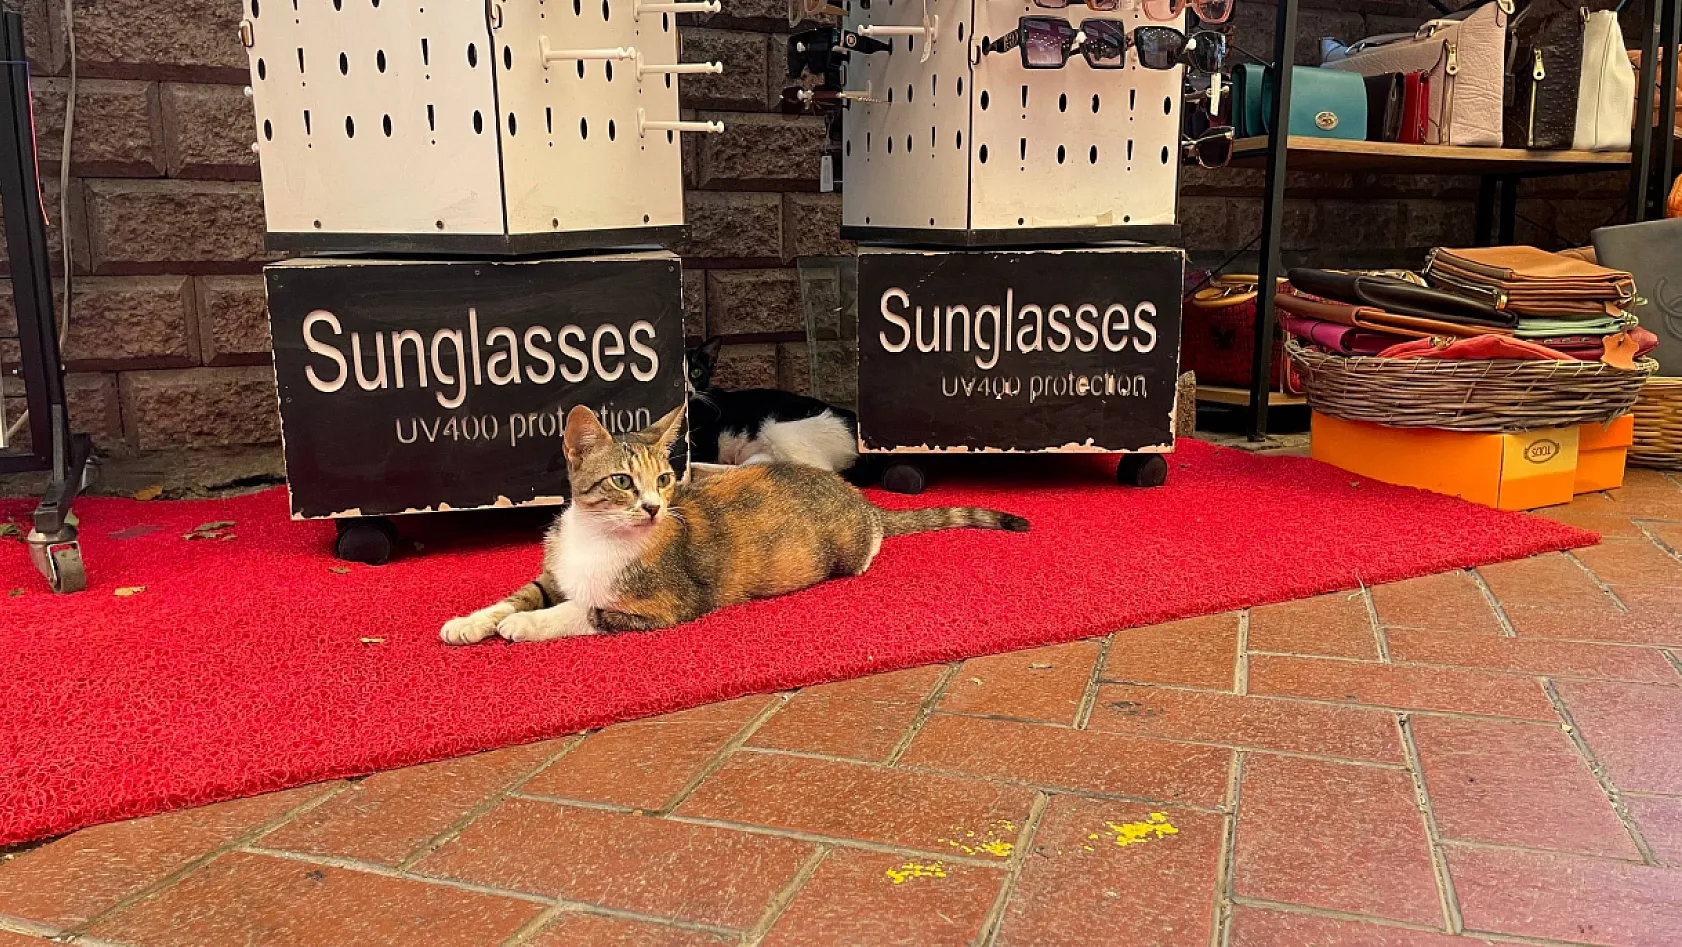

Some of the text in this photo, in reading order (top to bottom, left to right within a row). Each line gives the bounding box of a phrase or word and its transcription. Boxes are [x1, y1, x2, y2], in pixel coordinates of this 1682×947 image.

[302, 307, 660, 410] Sunglasses
[879, 286, 1157, 370] Sunglasses
[941, 368, 1147, 403] UV400 protection
[396, 401, 652, 447] UV400 prottion
